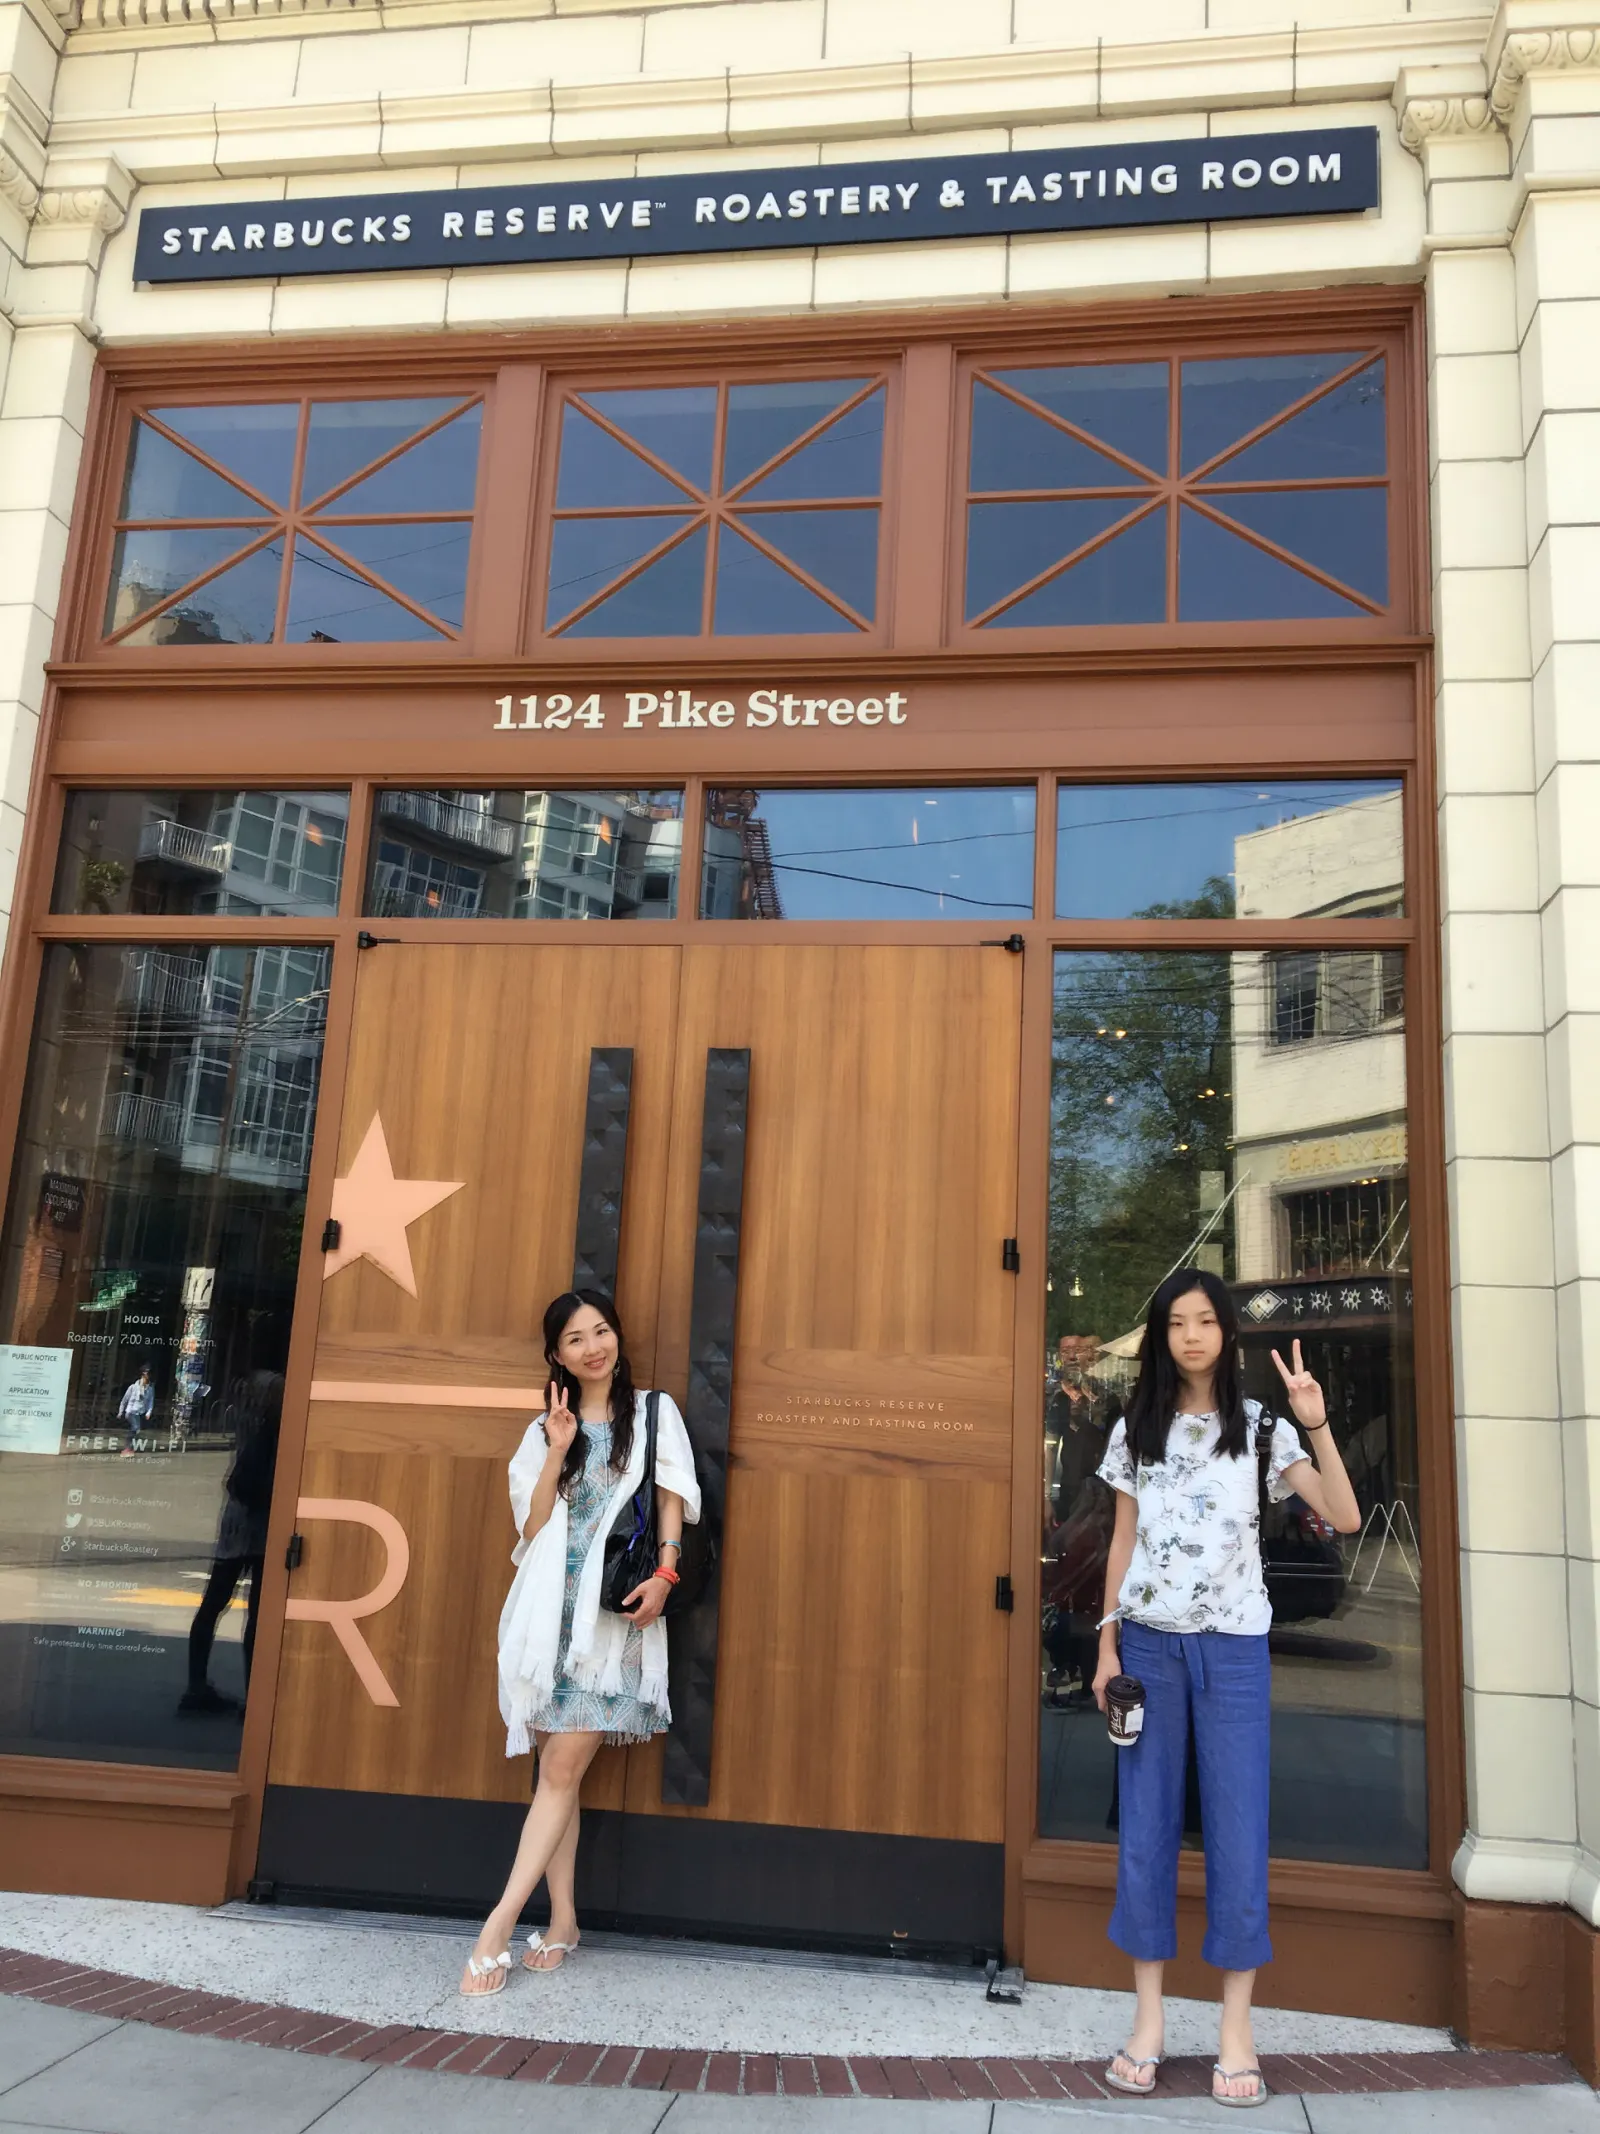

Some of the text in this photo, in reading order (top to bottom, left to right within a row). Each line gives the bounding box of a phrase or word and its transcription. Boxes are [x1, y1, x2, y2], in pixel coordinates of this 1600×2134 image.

[161, 213, 412, 255] STARBUCKS
[694, 182, 920, 223] ROASTERY
[939, 178, 965, 207] &
[986, 163, 1179, 204] TASTING
[1201, 152, 1341, 190] ROOM
[493, 689, 908, 730] 1124 Pike Street
[124, 1315, 160, 1325] HOURS
[67, 1331, 114, 1346] Roastery
[120, 1333, 142, 1345] 7:00
[144, 1337, 166, 1346] a.m.
[12, 1353, 58, 1362] PUBLIC NOTICE
[8, 1386, 50, 1396] APPLICATION
[786, 1395, 945, 1412] STARBUCKS RESERVE
[28, 1410, 53, 1418] LICENSE
[757, 1413, 975, 1432] ROASTERY AND TASTING ROOM
[66, 1435, 187, 1454] FREE WI-FI
[84, 1541, 160, 1556] StarbucksRoastery
[77, 1578, 138, 1590] NO SMOKING
[77, 1626, 126, 1637] WARNING!
[50, 1638, 85, 1649] protected
[86, 1641, 95, 1650] by
[115, 1643, 141, 1652] control
